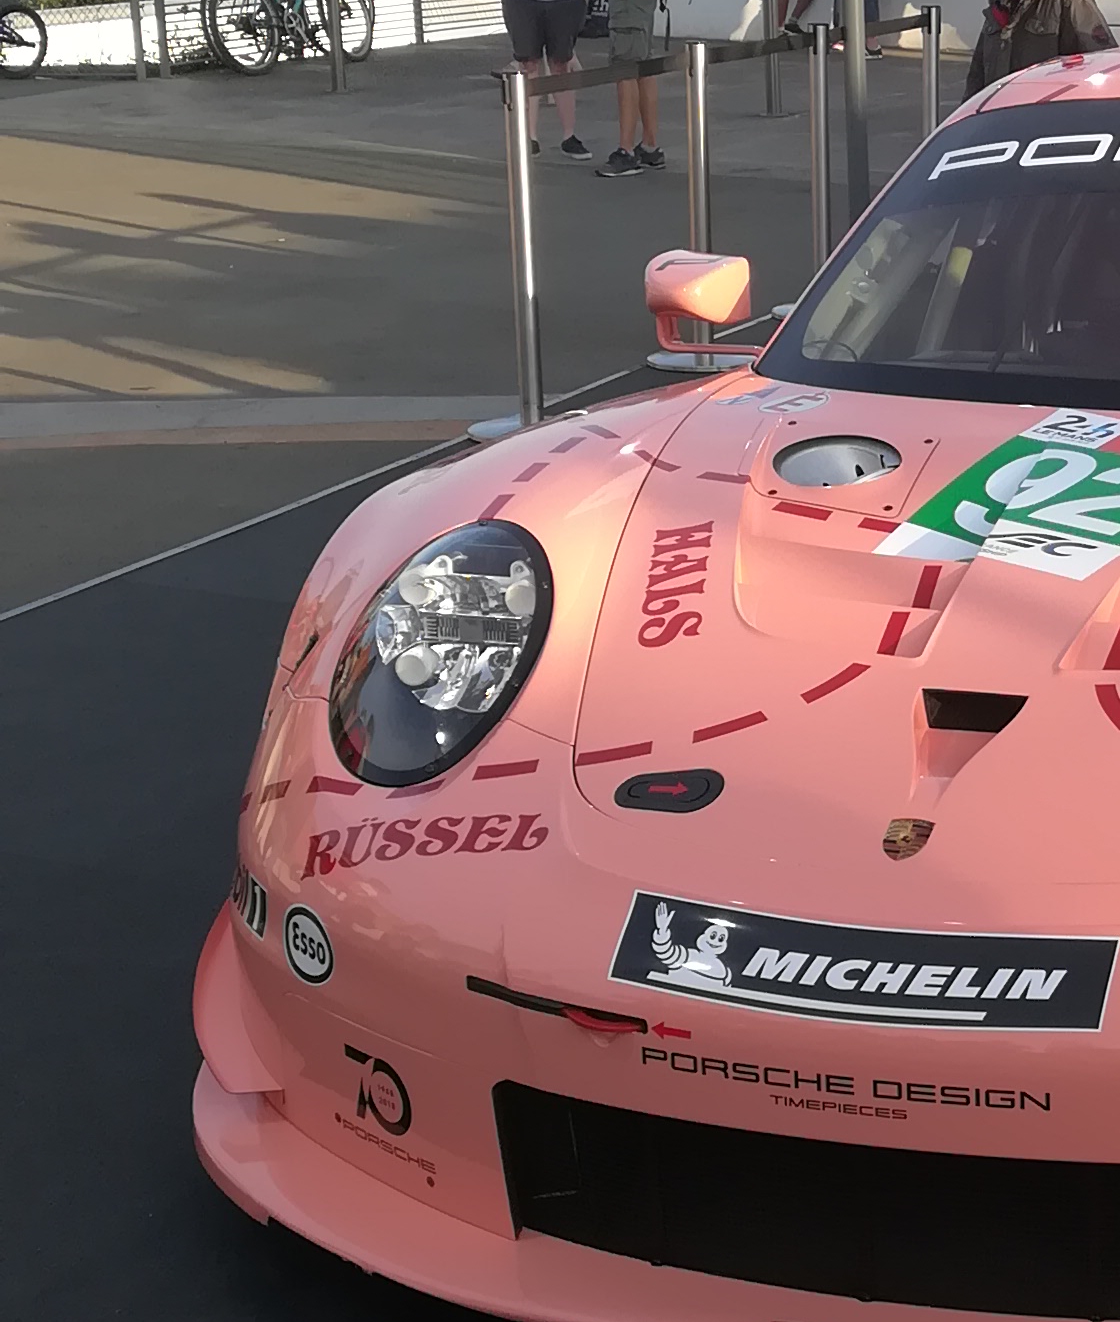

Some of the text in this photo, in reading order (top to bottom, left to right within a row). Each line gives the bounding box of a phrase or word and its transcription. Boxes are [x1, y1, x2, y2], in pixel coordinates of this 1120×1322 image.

[637, 520, 715, 648] HALS
[300, 813, 550, 882] RÜSSEL
[740, 945, 1068, 1002] MICHELIN
[344, 1042, 413, 1137] 70
[642, 1045, 1051, 1112] PORSCHE DESIGN
[769, 1093, 909, 1120] TIMEPIECES
[342, 1118, 438, 1176] PORSCHE
